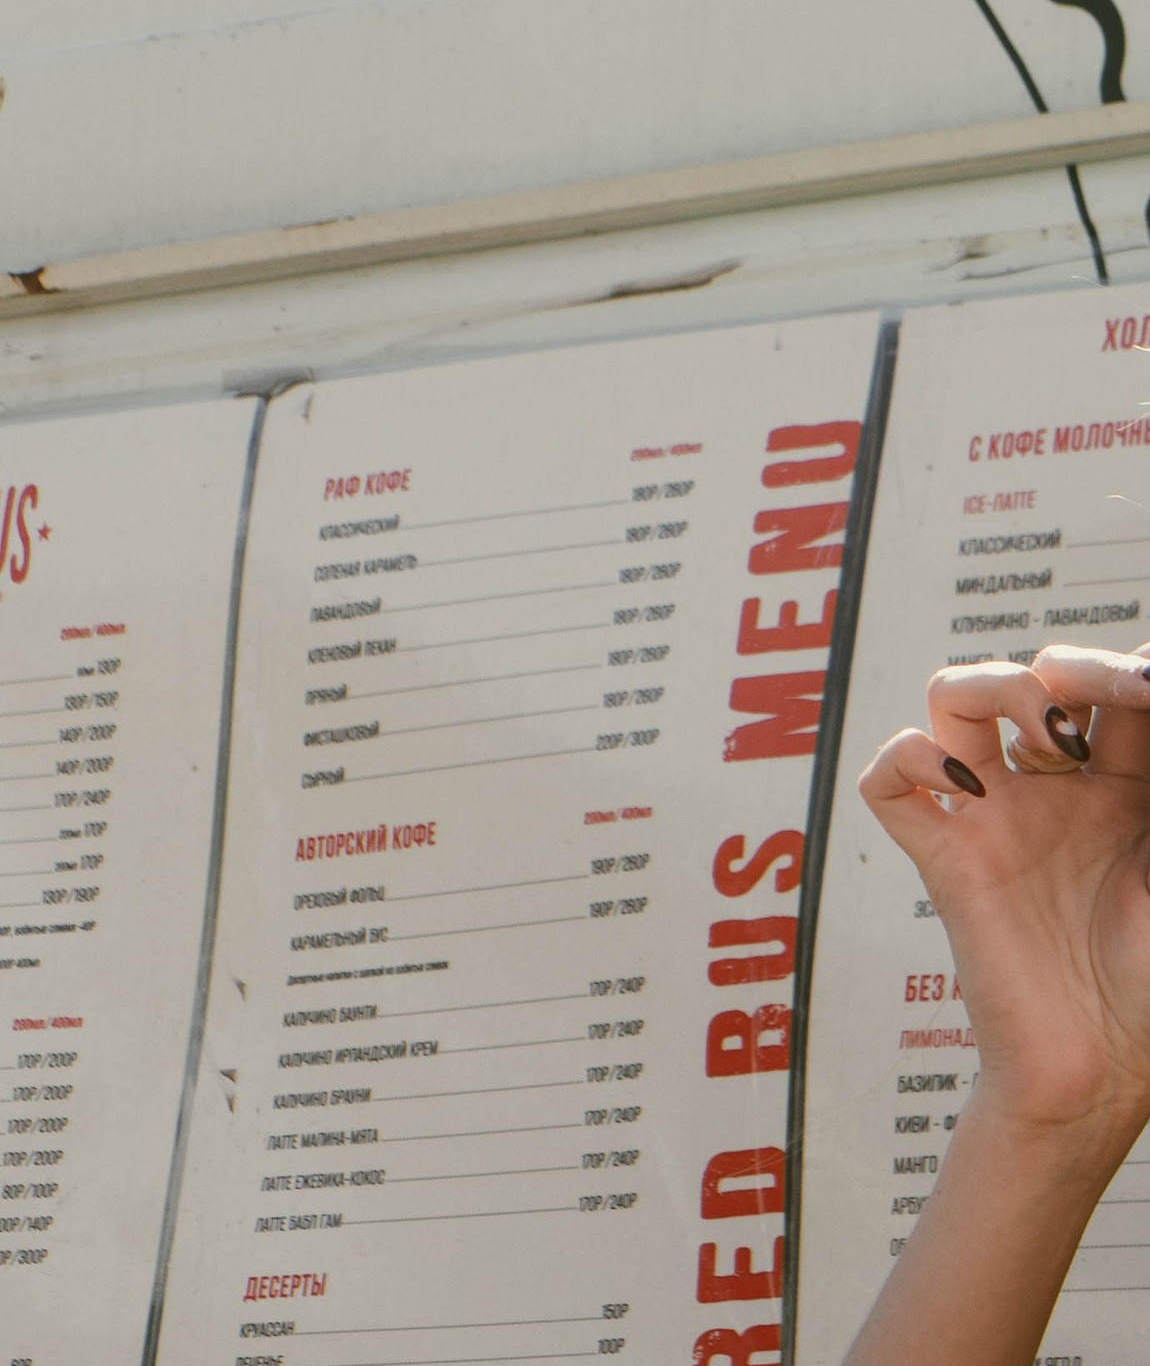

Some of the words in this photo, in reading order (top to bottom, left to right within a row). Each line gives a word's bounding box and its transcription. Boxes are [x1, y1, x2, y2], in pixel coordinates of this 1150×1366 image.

[988, 429, 1048, 460] КОФЕ
[324, 476, 361, 501] РАФ
[365, 468, 412, 495] КОФЕ
[723, 421, 862, 762] MENU
[955, 567, 1052, 595] МИНДАЛЬНЫЙ
[1043, 600, 1140, 627] ЛАВАНДОВЫЙ
[295, 824, 387, 862] АВТОРСКИЙ
[392, 822, 436, 851] КОФЕ
[705, 829, 804, 1078] BUS
[905, 974, 945, 1003] БЕЗ
[898, 1074, 958, 1093] БАЗИЛИК
[895, 1116, 930, 1134] КИВИ
[893, 1156, 938, 1175] МАНГО
[243, 1273, 327, 1302] ДЕСЕРТЫ
